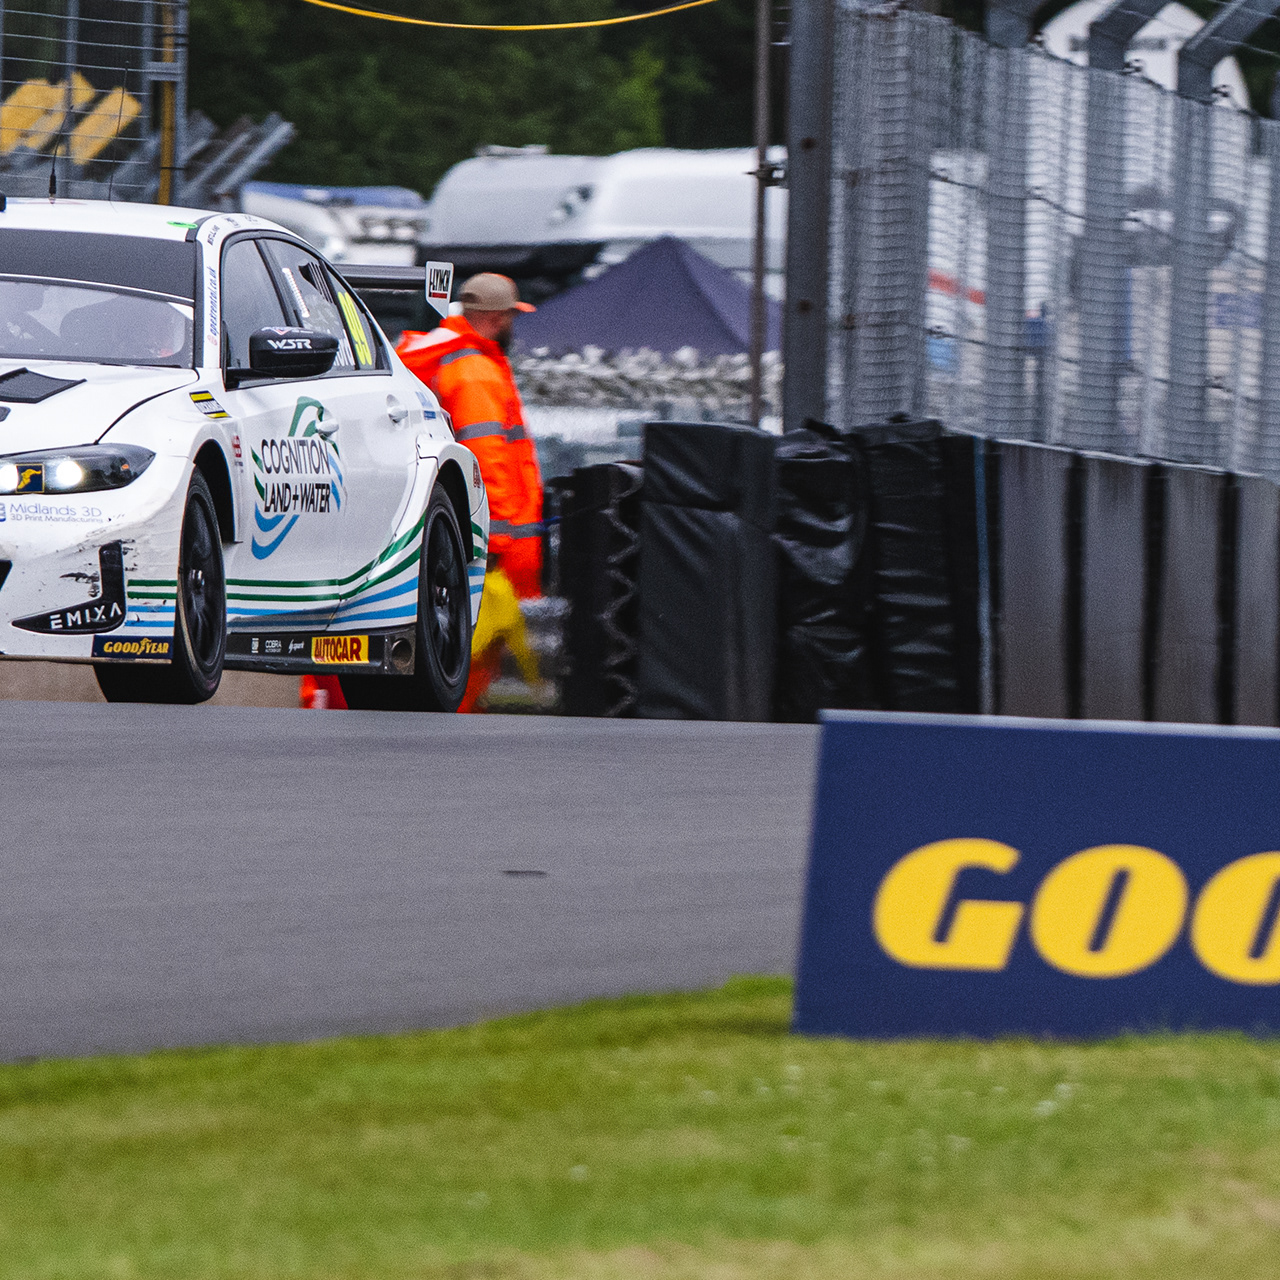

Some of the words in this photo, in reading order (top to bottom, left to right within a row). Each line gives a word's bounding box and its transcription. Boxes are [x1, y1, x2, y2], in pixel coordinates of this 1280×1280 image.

[337, 291, 373, 366] 99
[267, 339, 313, 350] WSR
[261, 438, 331, 474] COGNITION
[10, 503, 77, 516] Midlands
[82, 506, 102, 517] 3D
[11, 513, 23, 521] 3D
[25, 513, 43, 521] Print
[103, 637, 170, 655] GOODYEAR
[314, 636, 362, 663] AUTOCAR
